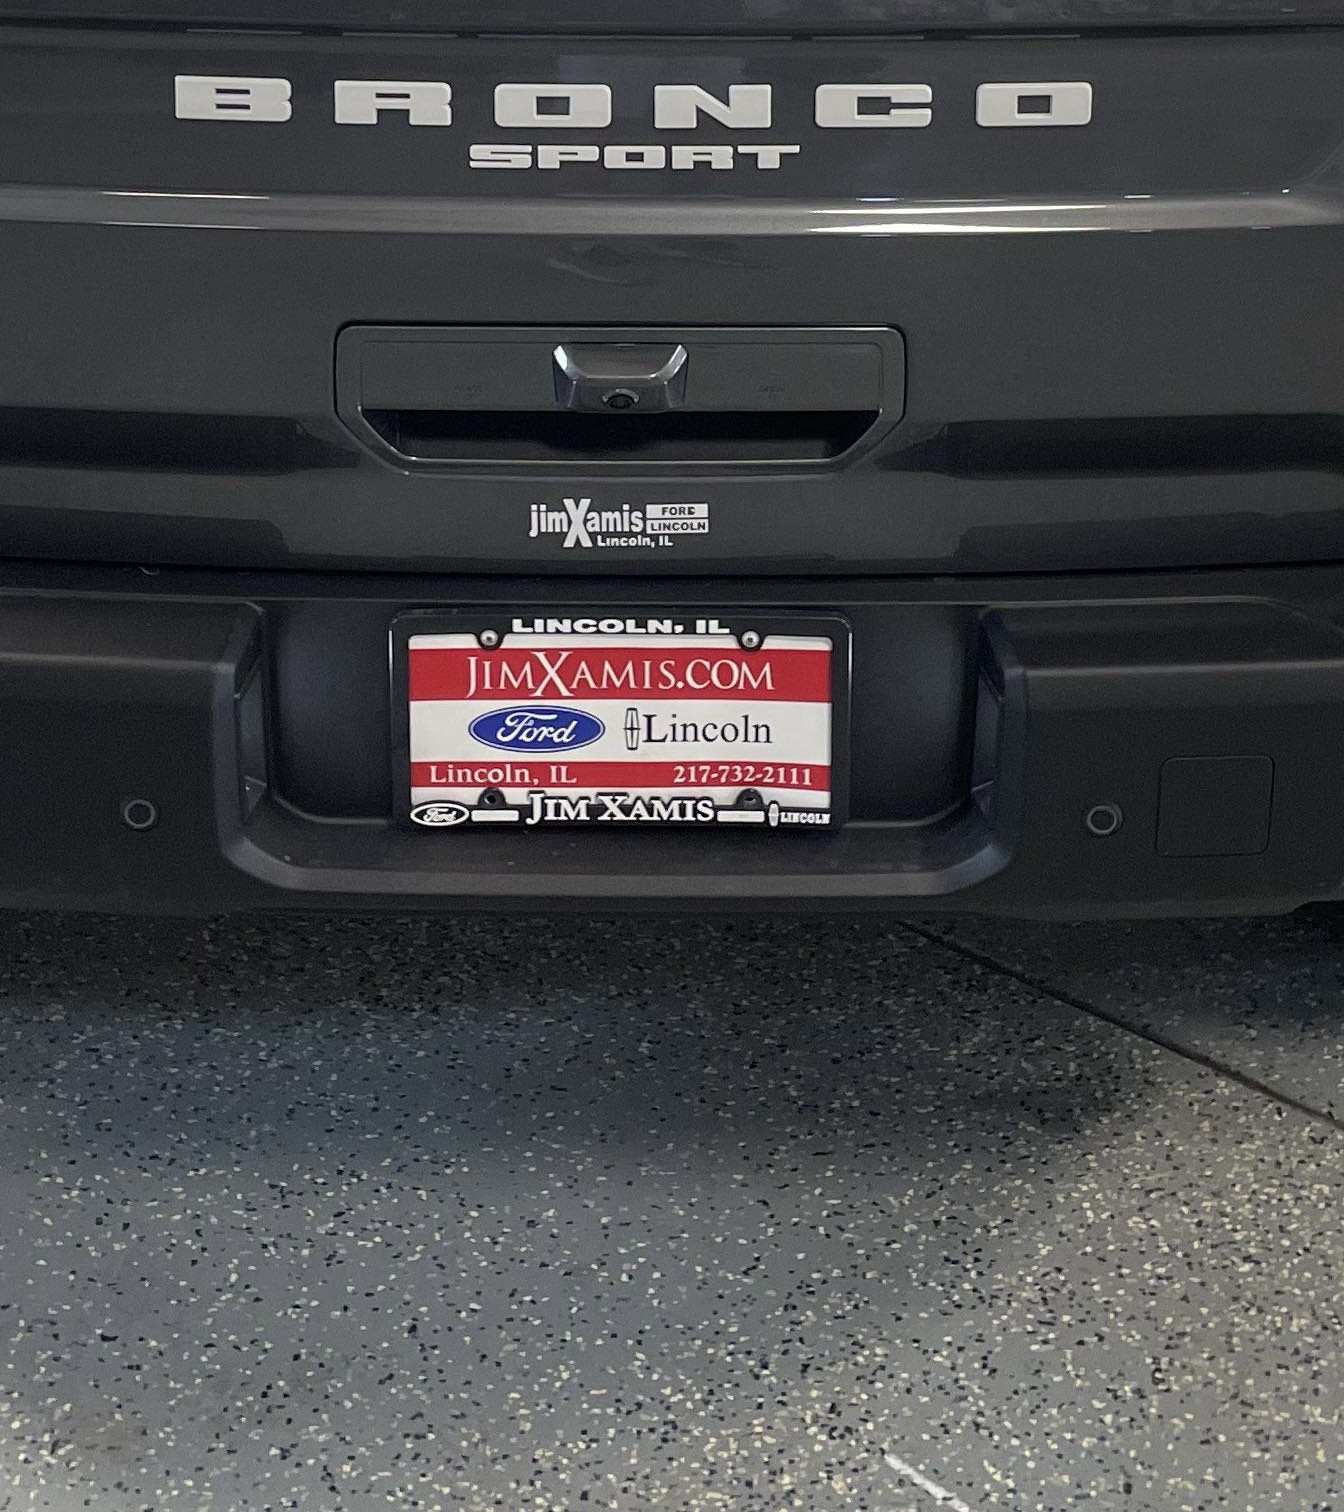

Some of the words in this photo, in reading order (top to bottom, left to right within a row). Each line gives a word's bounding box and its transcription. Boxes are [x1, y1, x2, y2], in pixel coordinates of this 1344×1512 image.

[173, 74, 1093, 129] BRONCO
[469, 143, 801, 171] SPORT
[650, 521, 706, 531] LINCOLN
[597, 535, 656, 548] Lincoln,
[659, 535, 674, 546] IL
[512, 618, 684, 635] LINCOLN,
[695, 618, 731, 635] IL
[496, 711, 577, 744] Ford
[642, 713, 773, 744] Lincoln
[429, 764, 540, 786] Lincoln,
[550, 765, 577, 785] IL
[673, 764, 813, 786] 217-732-2111
[525, 793, 590, 825] JIM
[598, 794, 716, 823] XAMIS
[780, 811, 831, 824] LINCOLN
